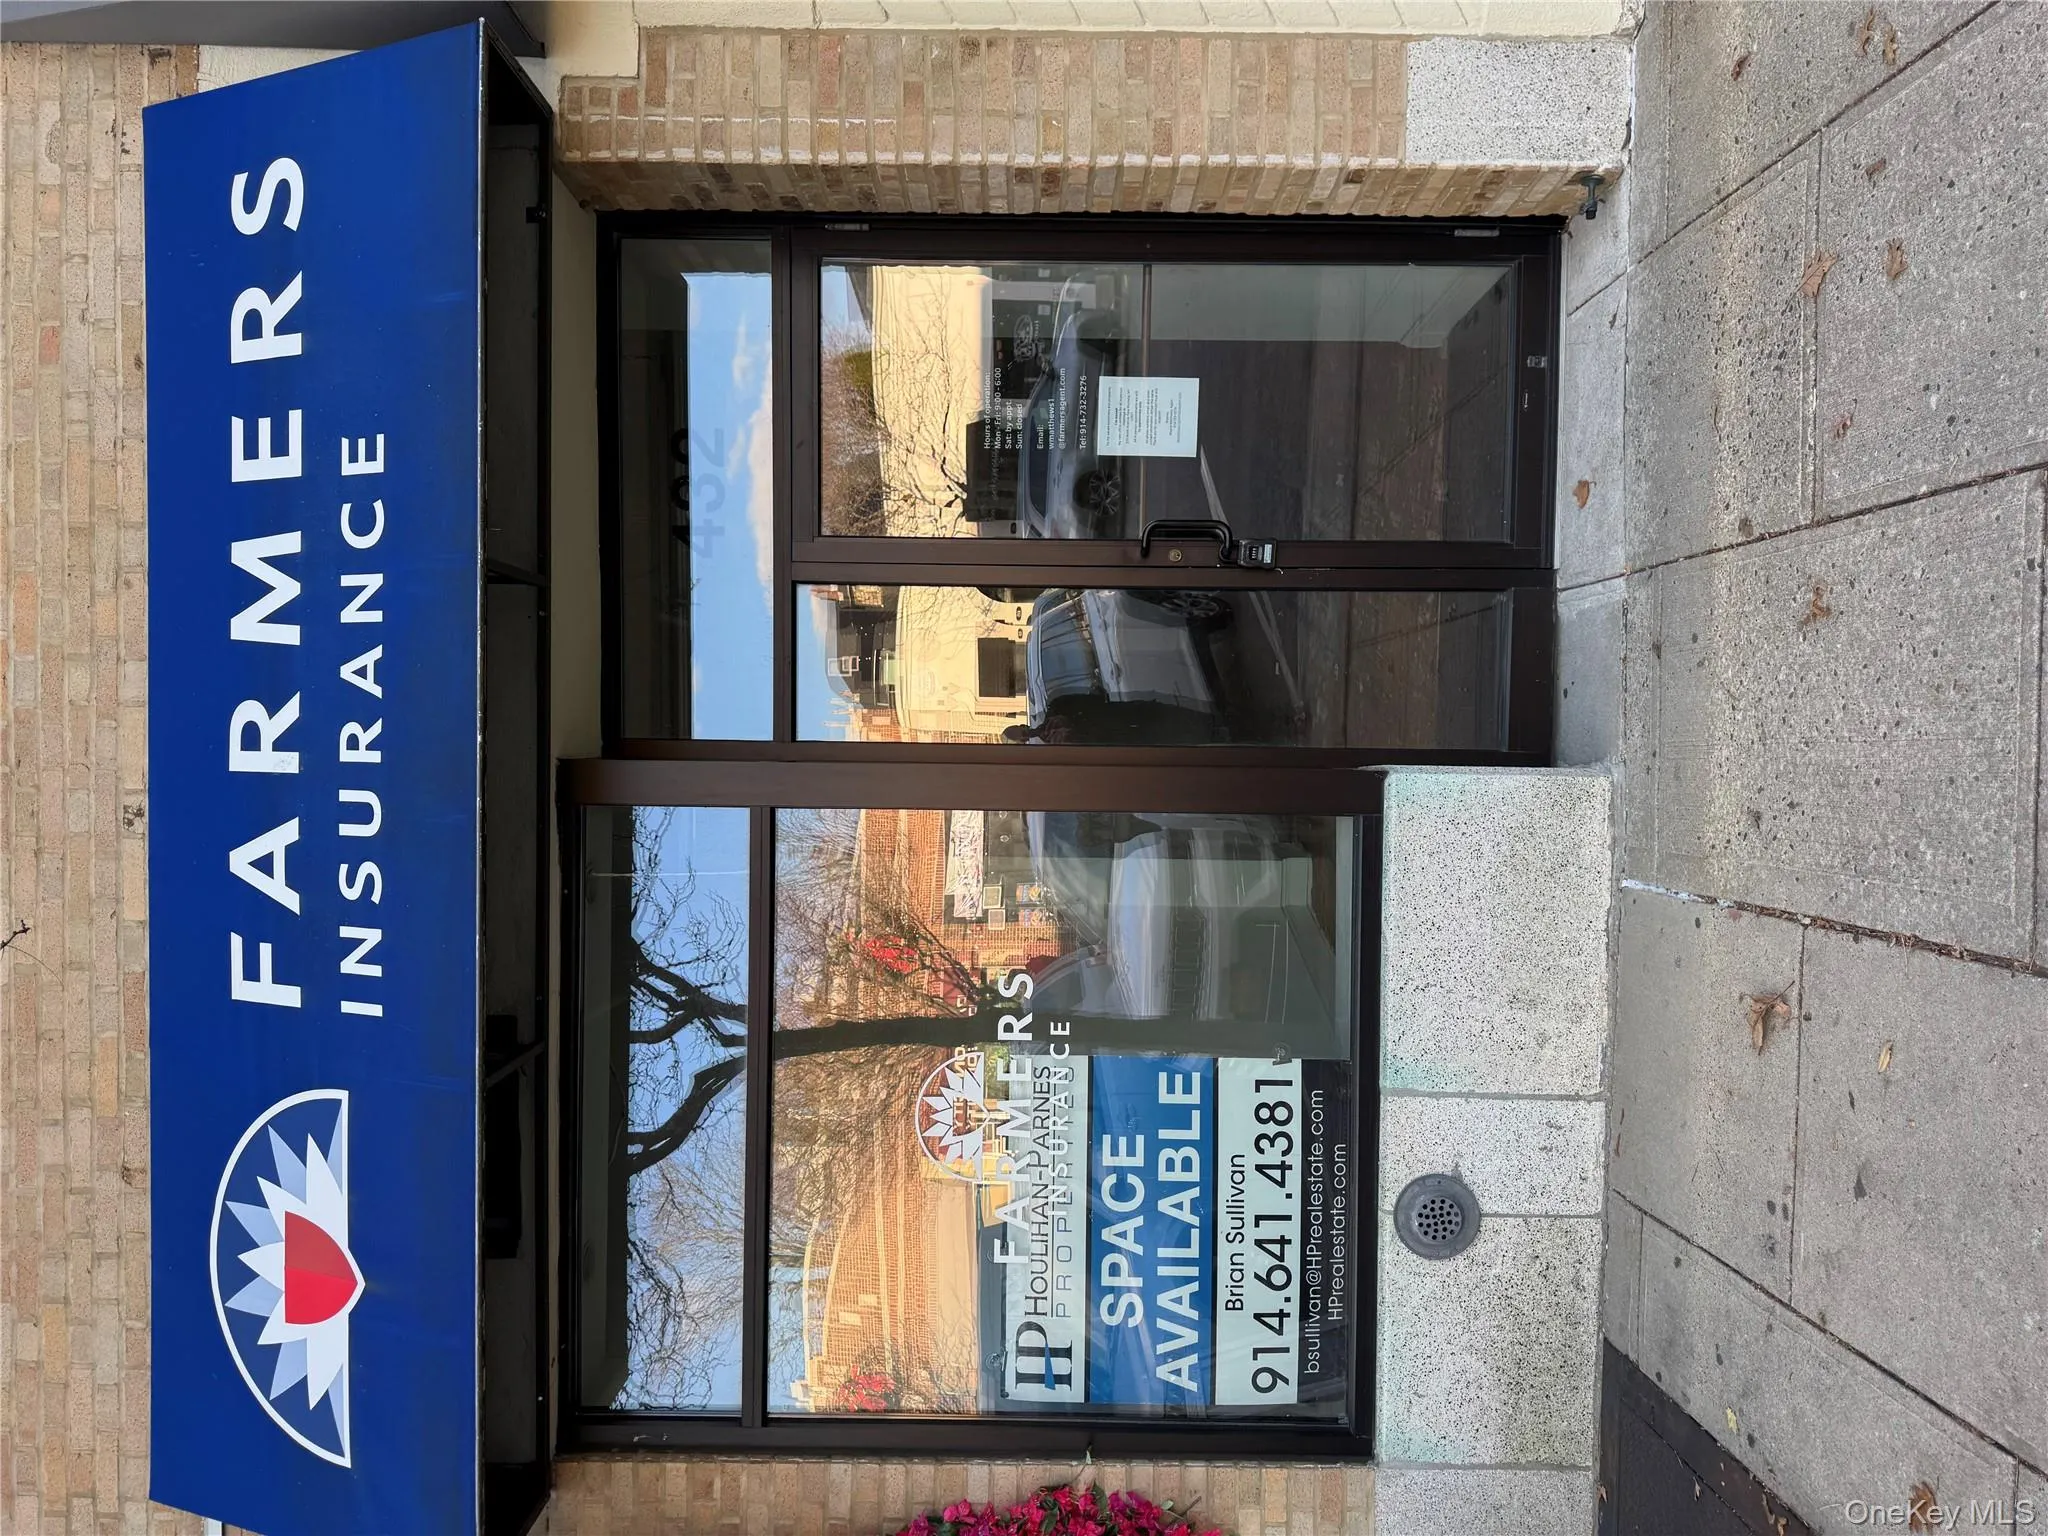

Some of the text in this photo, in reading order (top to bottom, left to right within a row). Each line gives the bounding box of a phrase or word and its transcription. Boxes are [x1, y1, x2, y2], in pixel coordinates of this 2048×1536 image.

[984, 372, 992, 414] operation:
[984, 414, 990, 424] of
[1005, 422, 1013, 432] by
[1058, 368, 1066, 450] @farmersagent.com
[229, 157, 304, 1008] FARMERS
[670, 427, 726, 559] 432
[339, 433, 385, 1017] INSURANCE
[993, 972, 1034, 1264] FARMERS
[1024, 1065, 1051, 1317] HOULIHAN-PARNES
[1046, 1021, 1070, 1216] INSURANCE
[1099, 1134, 1145, 1328] SPACE
[1155, 1071, 1201, 1393] AVAILABLE
[1225, 1153, 1245, 1311] Brian Sullivan
[1250, 1078, 1294, 1394] 914.641.4381
[1304, 1089, 1325, 1374] bsullivan@HPrealestate.com
[1328, 1143, 1347, 1321] HPrealestate.com
